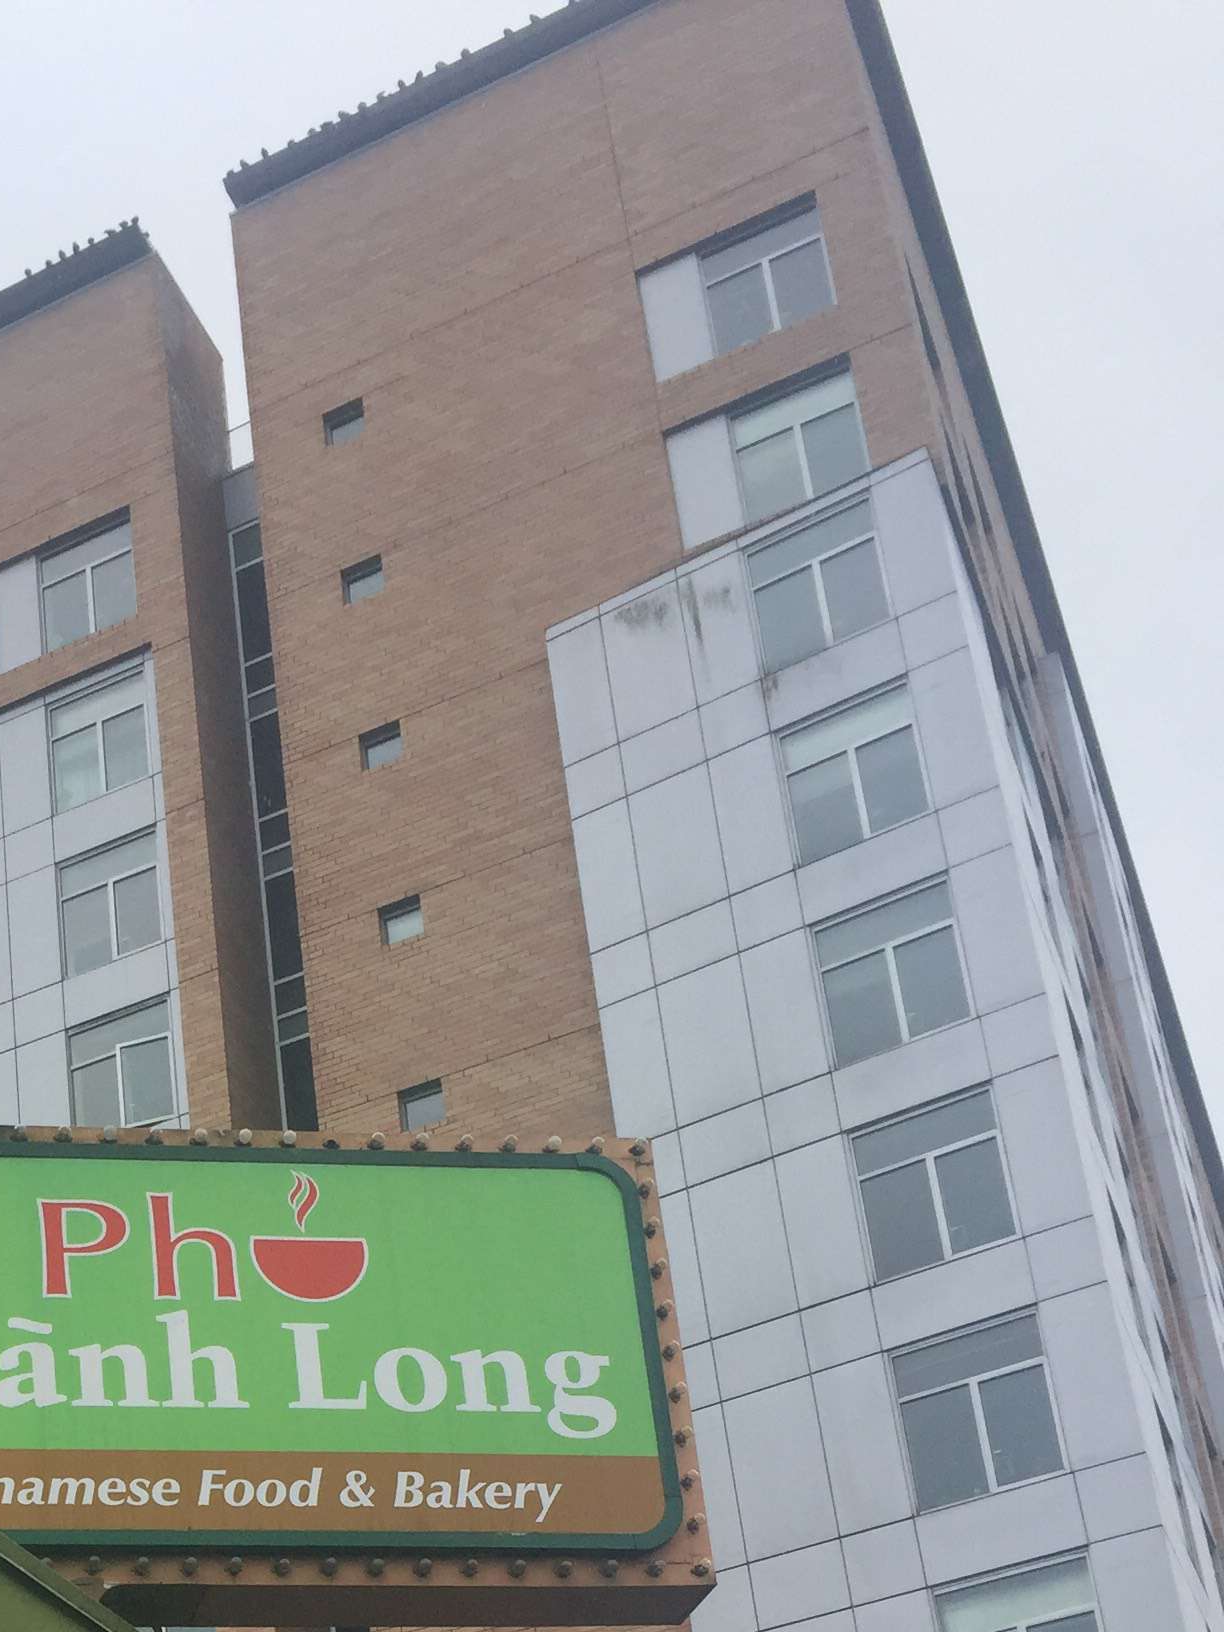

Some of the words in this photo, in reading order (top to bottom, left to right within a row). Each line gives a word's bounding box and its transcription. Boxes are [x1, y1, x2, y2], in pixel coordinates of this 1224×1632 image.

[281, 1322, 617, 1439] Long
[198, 1467, 323, 1508] Food
[339, 1470, 376, 1508] &
[393, 1469, 562, 1523] Bakery
